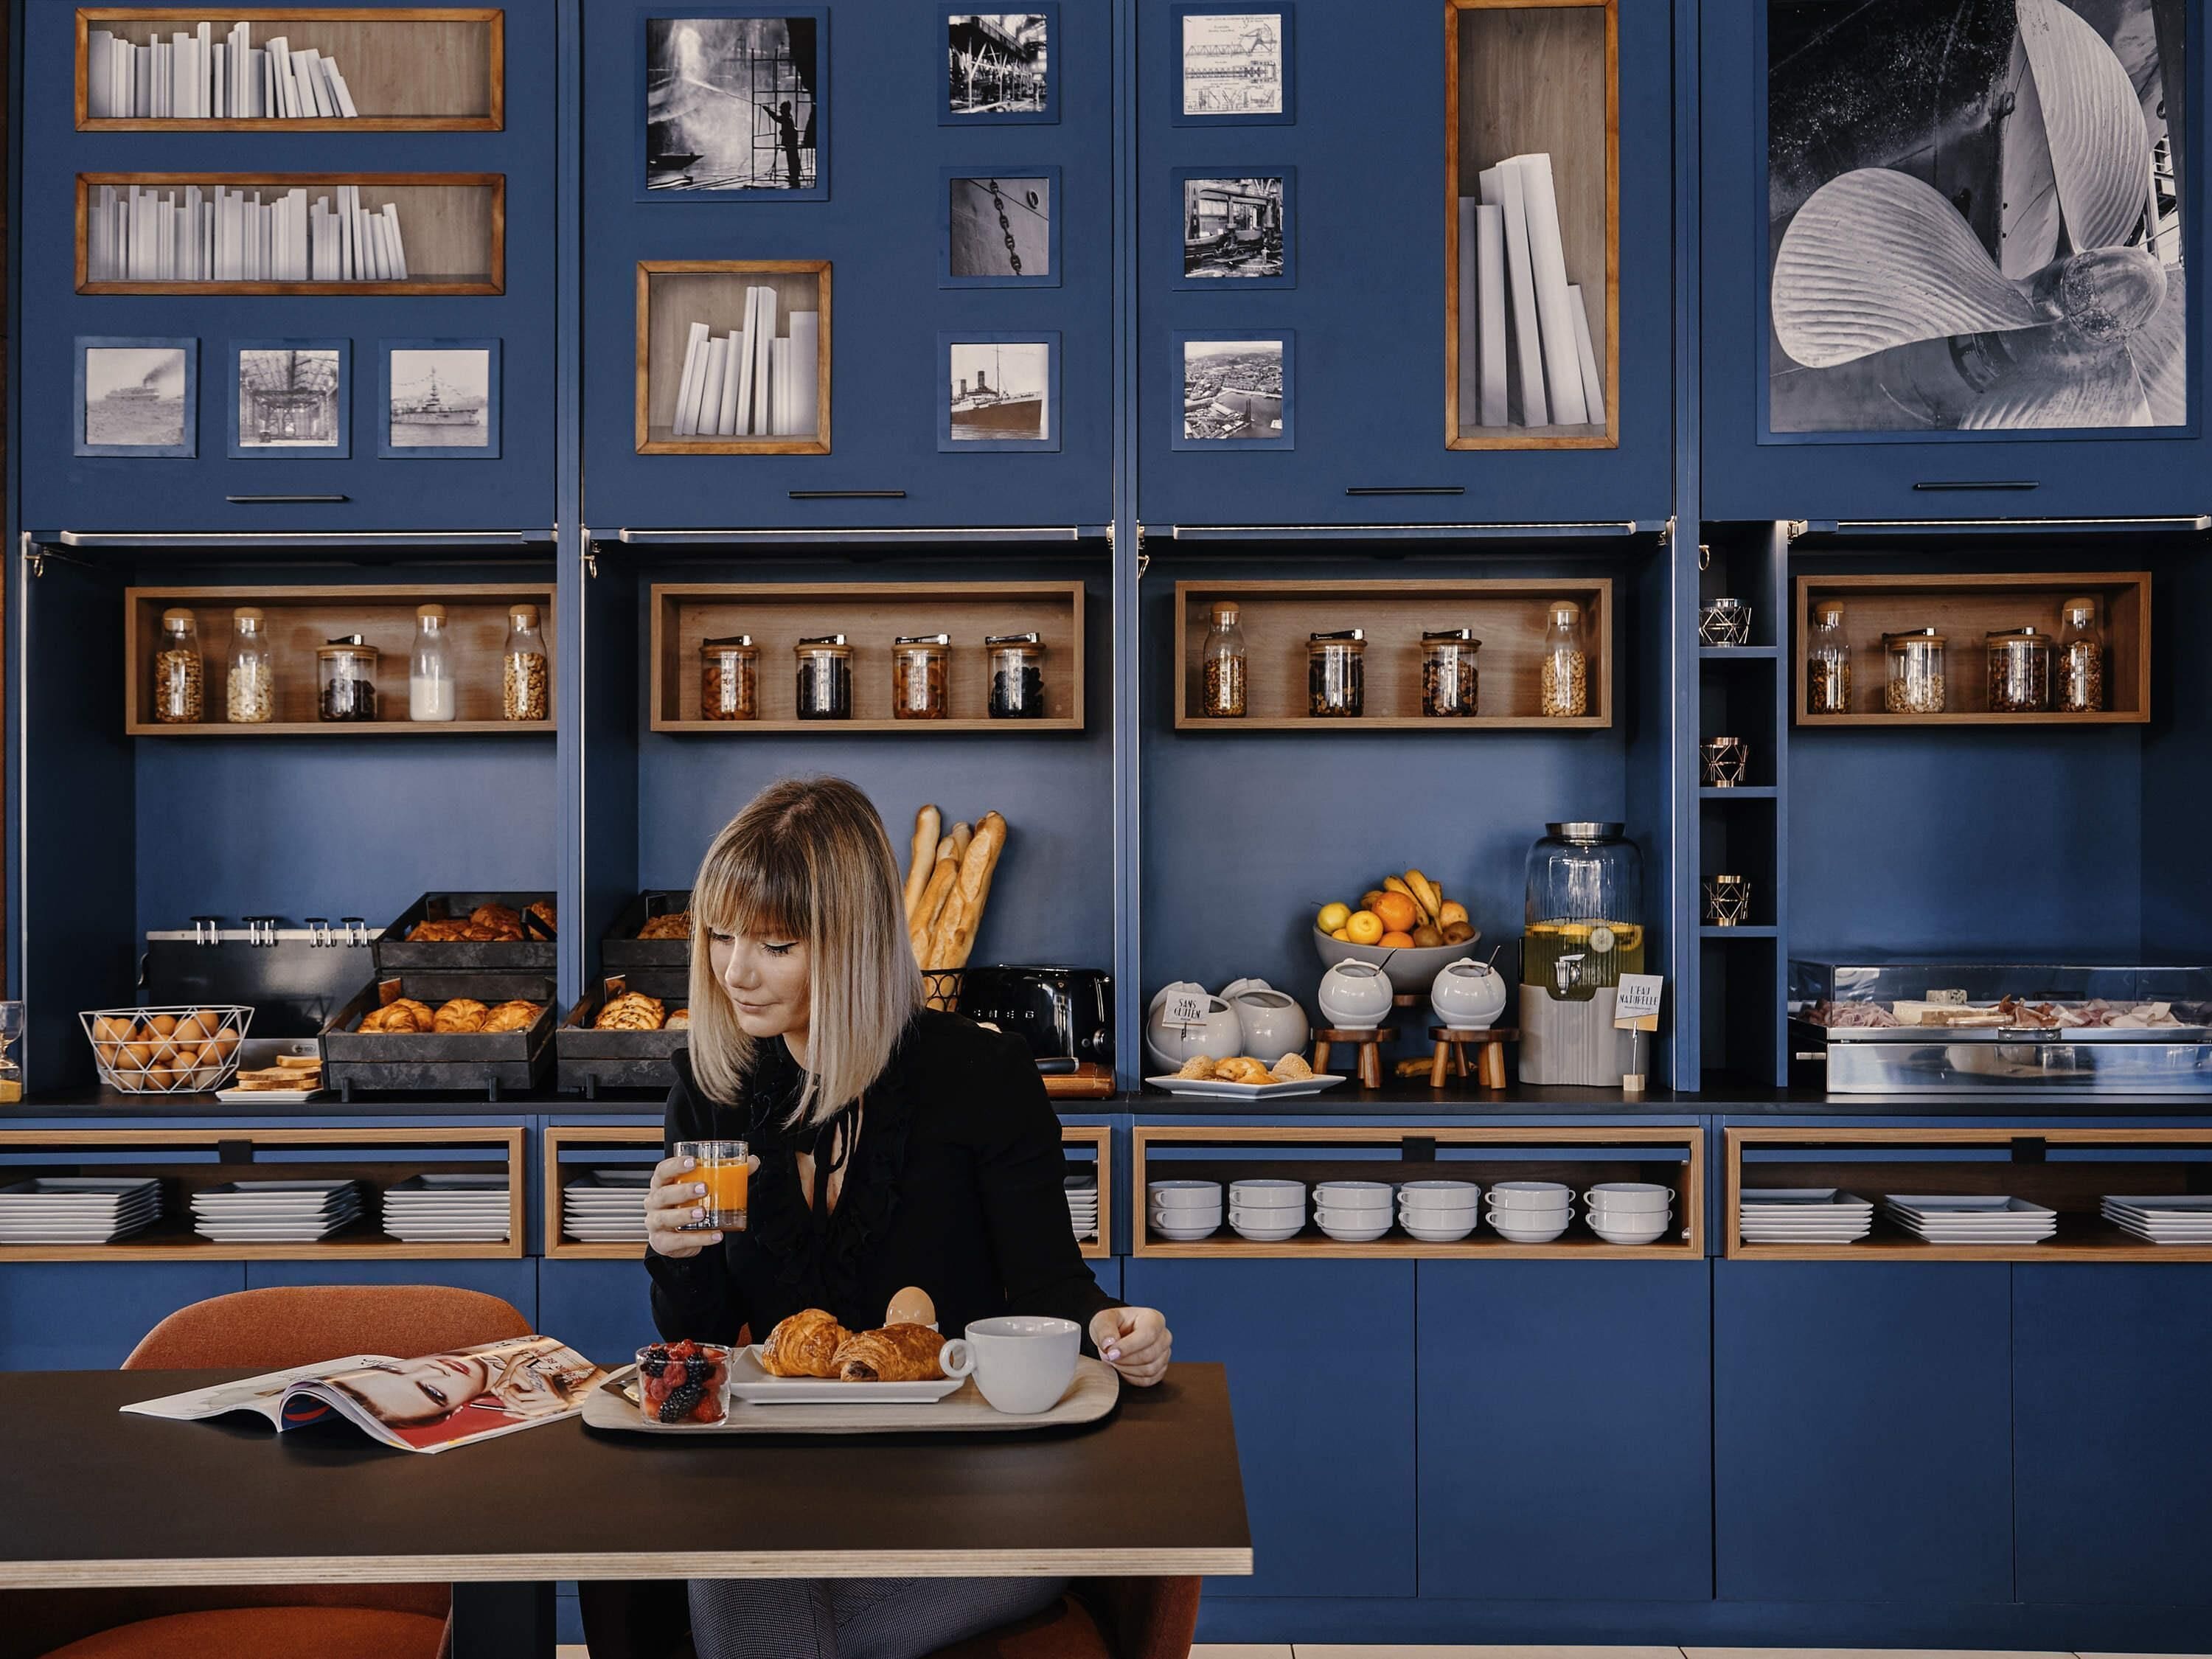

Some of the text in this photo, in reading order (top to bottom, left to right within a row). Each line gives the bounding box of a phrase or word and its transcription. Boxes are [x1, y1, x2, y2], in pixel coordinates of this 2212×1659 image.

[1179, 998, 1197, 1009] SANS
[1620, 993, 1658, 1006] NATURELLE
[973, 1009, 1034, 1019] SMEG
[1174, 1007, 1201, 1018] GLUTEN
